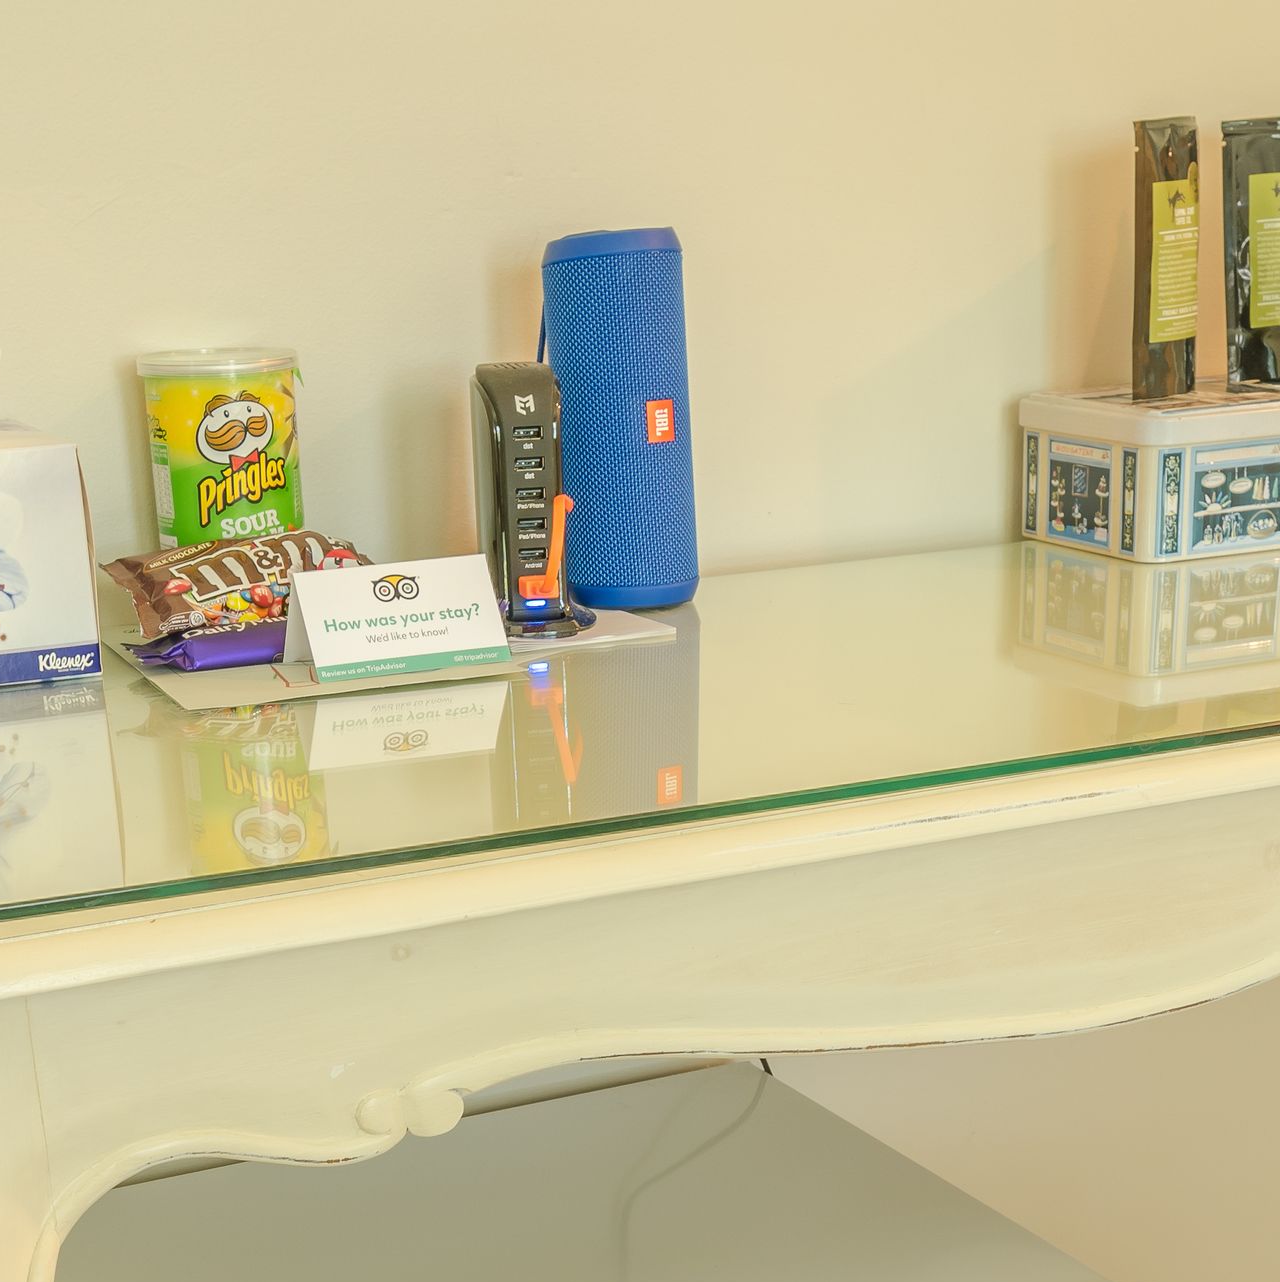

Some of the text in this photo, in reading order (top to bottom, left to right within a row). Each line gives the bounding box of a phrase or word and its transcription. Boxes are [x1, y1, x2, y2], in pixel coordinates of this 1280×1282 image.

[654, 408, 668, 436] JBL
[198, 451, 286, 528] Pringles
[220, 509, 280, 538] SOUR
[149, 542, 212, 569] MILK CHOCOLATE
[324, 603, 481, 633] How was your stay?
[366, 627, 450, 644] We'd like to know!
[38, 652, 93, 672] Kleenex
[322, 670, 347, 678] Review
[366, 662, 406, 673] TripAdvisor
[464, 652, 498, 661] tripadvisor
